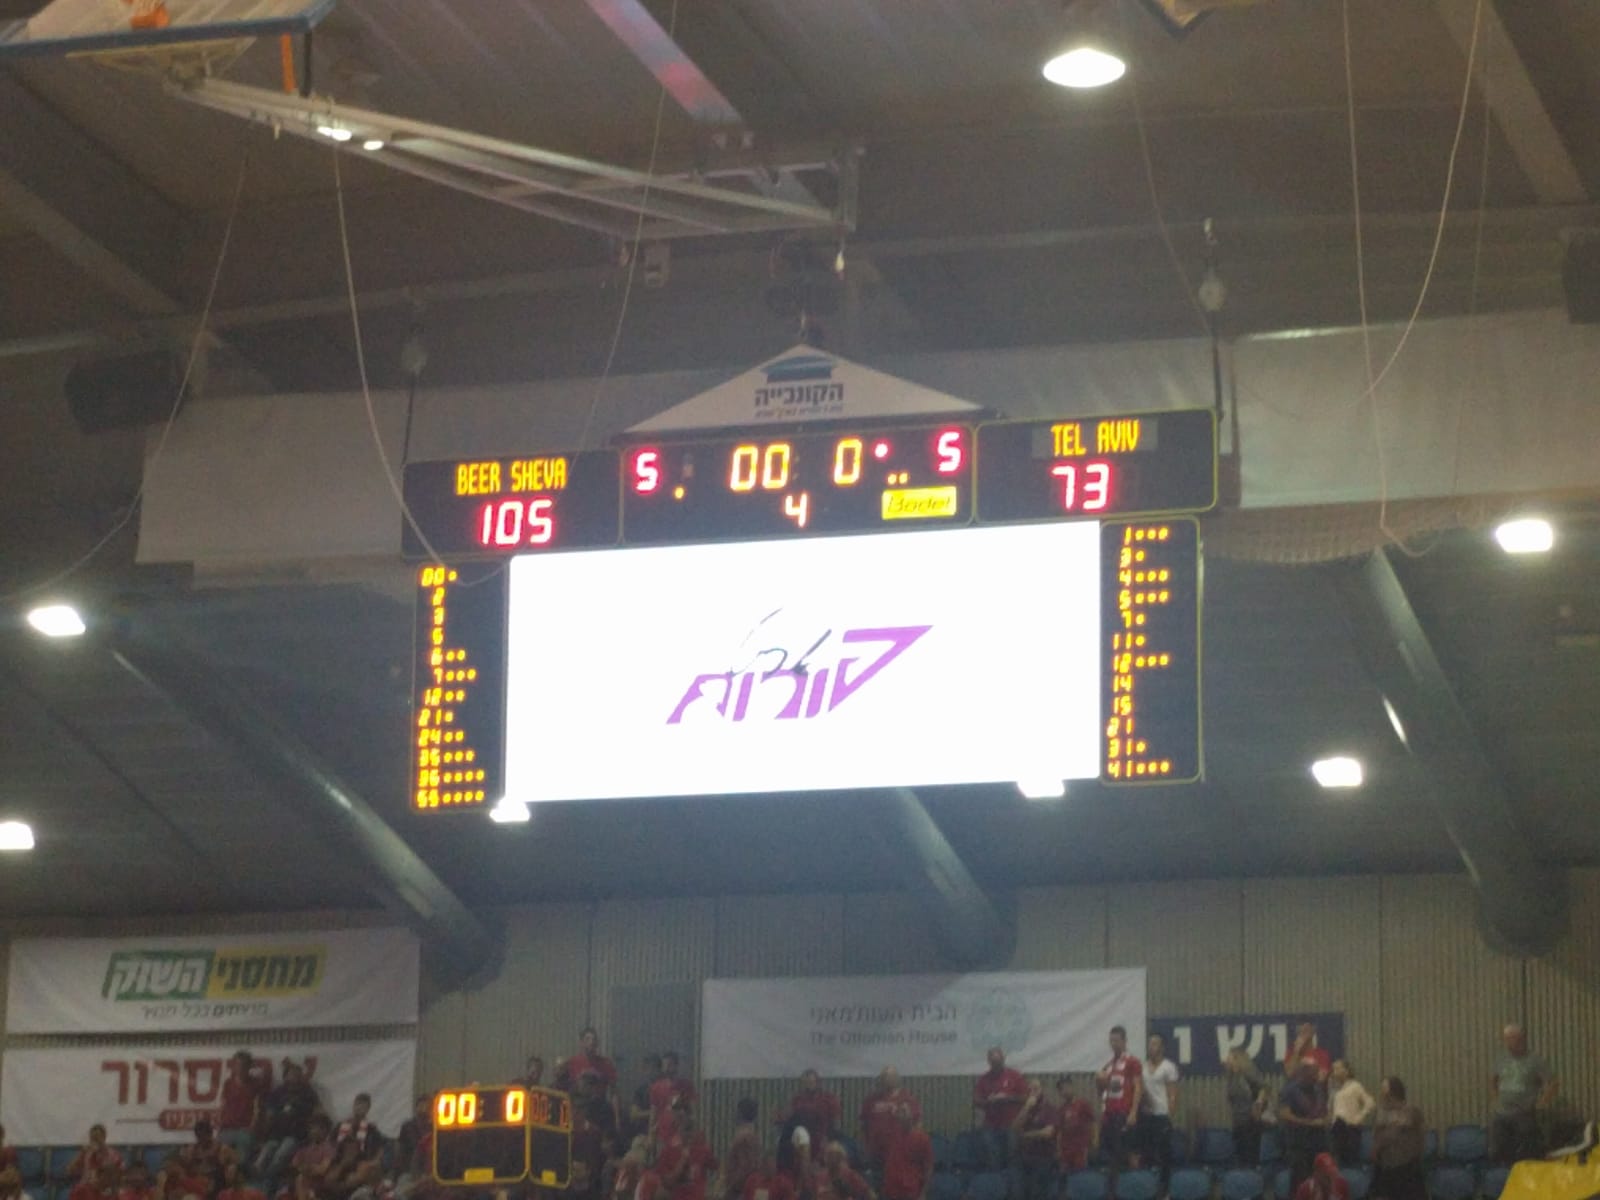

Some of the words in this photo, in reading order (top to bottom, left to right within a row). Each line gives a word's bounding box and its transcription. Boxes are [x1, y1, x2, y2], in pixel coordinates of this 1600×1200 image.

[754, 384, 844, 406] הקונכייה
[1051, 424, 1086, 457] TEL
[1097, 419, 1140, 454] AVIV
[456, 461, 501, 496] BEER
[510, 457, 567, 493] SHEVA
[728, 443, 791, 492] 00
[832, 437, 863, 486] 0
[1050, 461, 1113, 512] 73
[480, 498, 553, 546] 105
[783, 492, 810, 529] 4
[422, 567, 445, 587] 00
[107, 957, 208, 1002] השוק
[217, 955, 319, 991] מחסני
[911, 1002, 957, 1021] הבית
[809, 1030, 837, 1046] The
[839, 1029, 906, 1047] Ottoman
[908, 1028, 958, 1045] House
[436, 1092, 477, 1127] 00
[504, 1089, 526, 1124] 0
